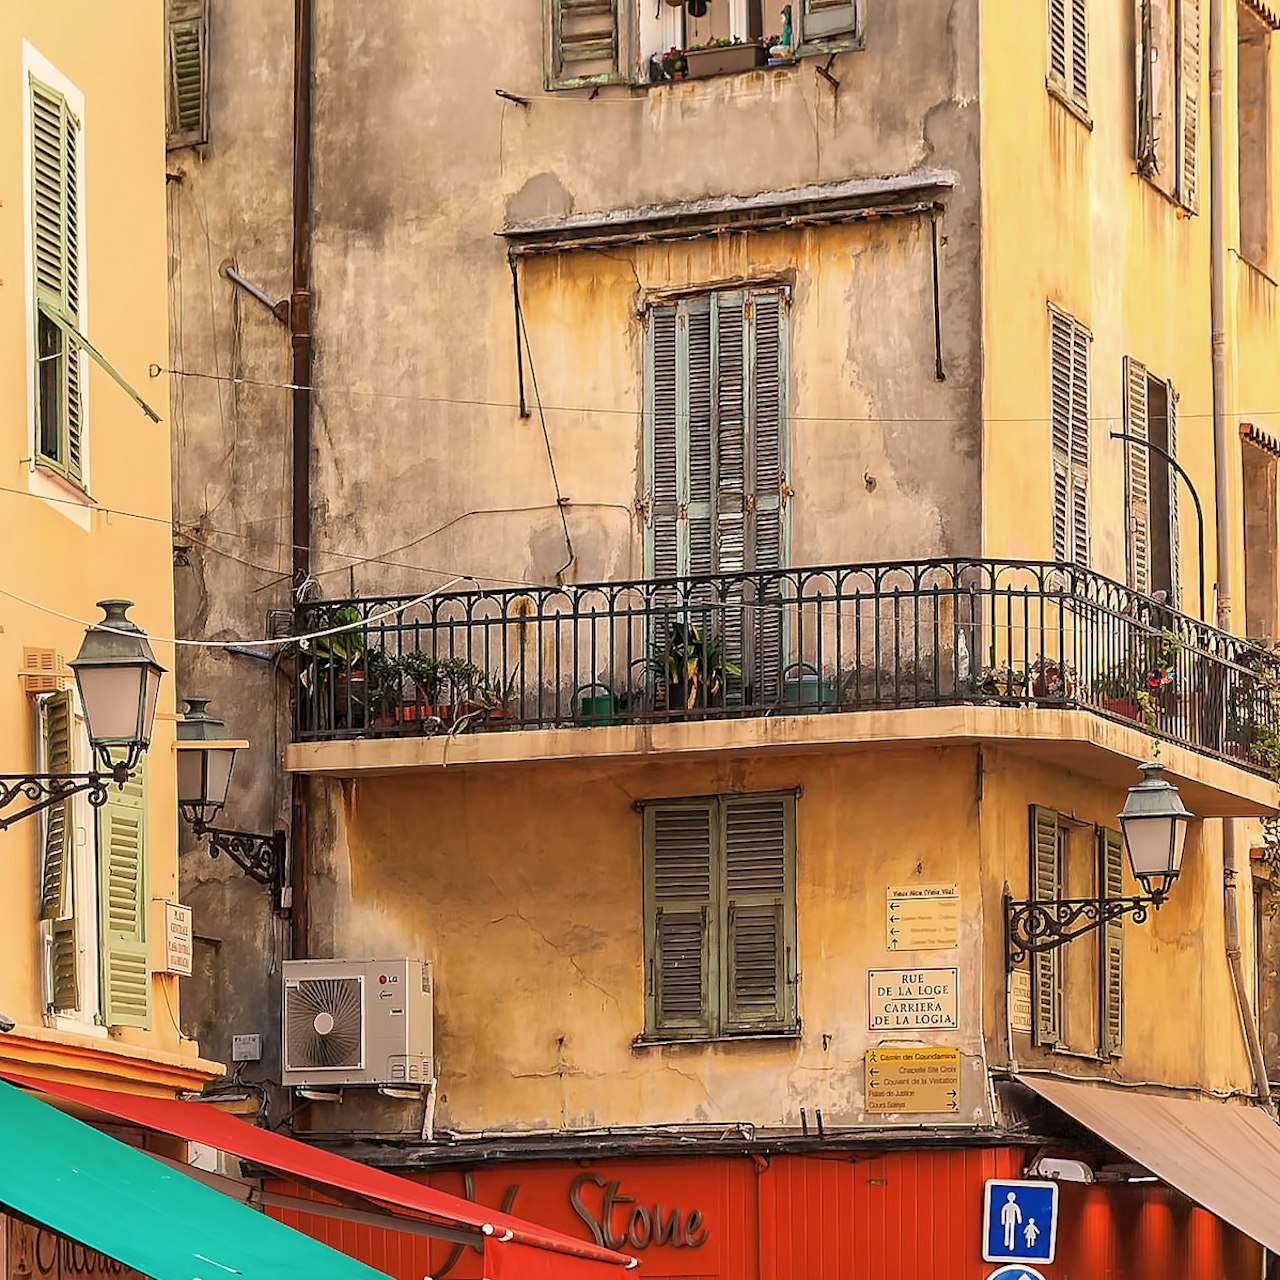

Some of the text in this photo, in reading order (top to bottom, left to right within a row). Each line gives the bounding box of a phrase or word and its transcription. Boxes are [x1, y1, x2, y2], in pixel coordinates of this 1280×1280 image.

[901, 973, 924, 984] RUE
[877, 985, 949, 996] DE LA LOGE
[884, 1003, 942, 1014] CARRIERA
[874, 1013, 952, 1025] DE LA LOGIA
[898, 1066, 926, 1074] Chapelle
[569, 1171, 709, 1251] Stone
